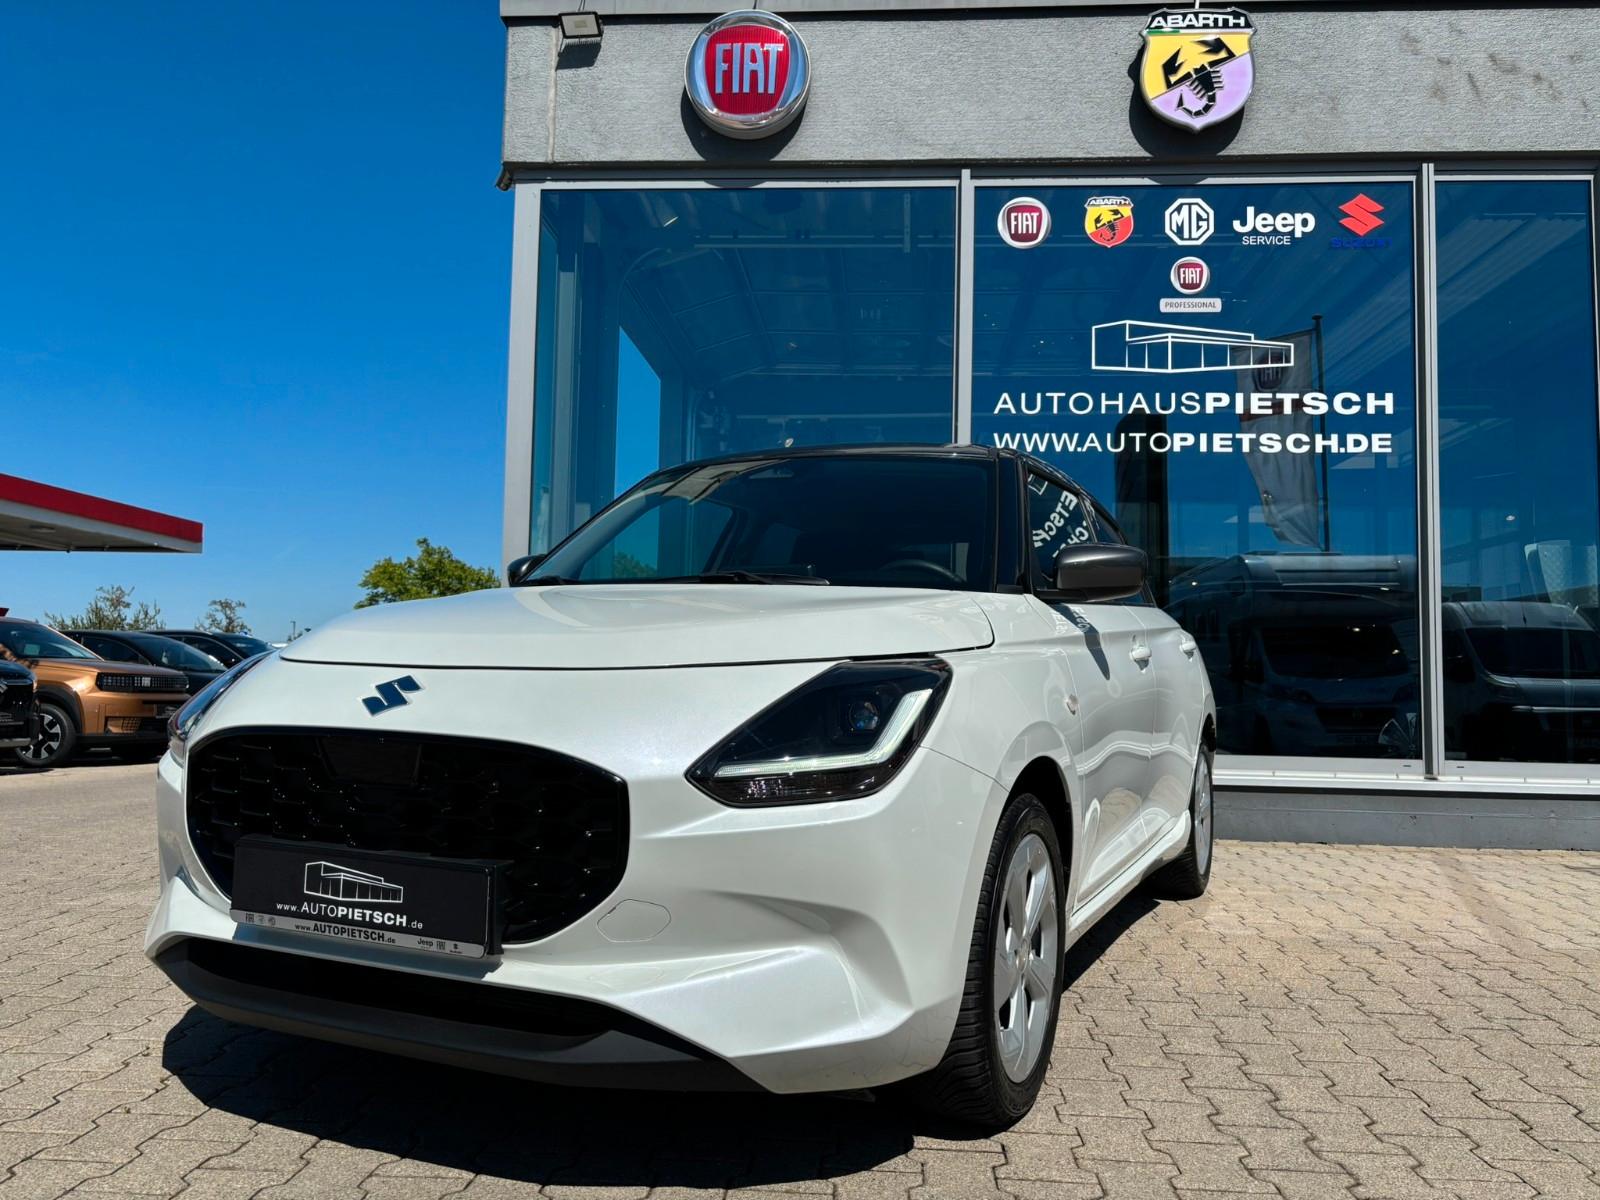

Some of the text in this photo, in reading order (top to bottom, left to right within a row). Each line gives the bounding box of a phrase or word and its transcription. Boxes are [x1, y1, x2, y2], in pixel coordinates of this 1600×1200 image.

[1150, 13, 1246, 28] ABARTH
[715, 43, 784, 94] FIAT
[1010, 212, 1040, 234] FIAT
[1171, 204, 1208, 240] MG
[1232, 206, 1315, 237] Jeep
[1242, 235, 1291, 245] SERVICE
[1180, 267, 1201, 284] FIAT
[1165, 301, 1216, 309] PROFESSIONAL
[993, 432, 1393, 453] WWW.AUTOPIETSCH.DE
[276, 901, 423, 930] www.AUTOPIETSCH.de
[294, 922, 396, 944] www.AUTOPIETSCH.de
